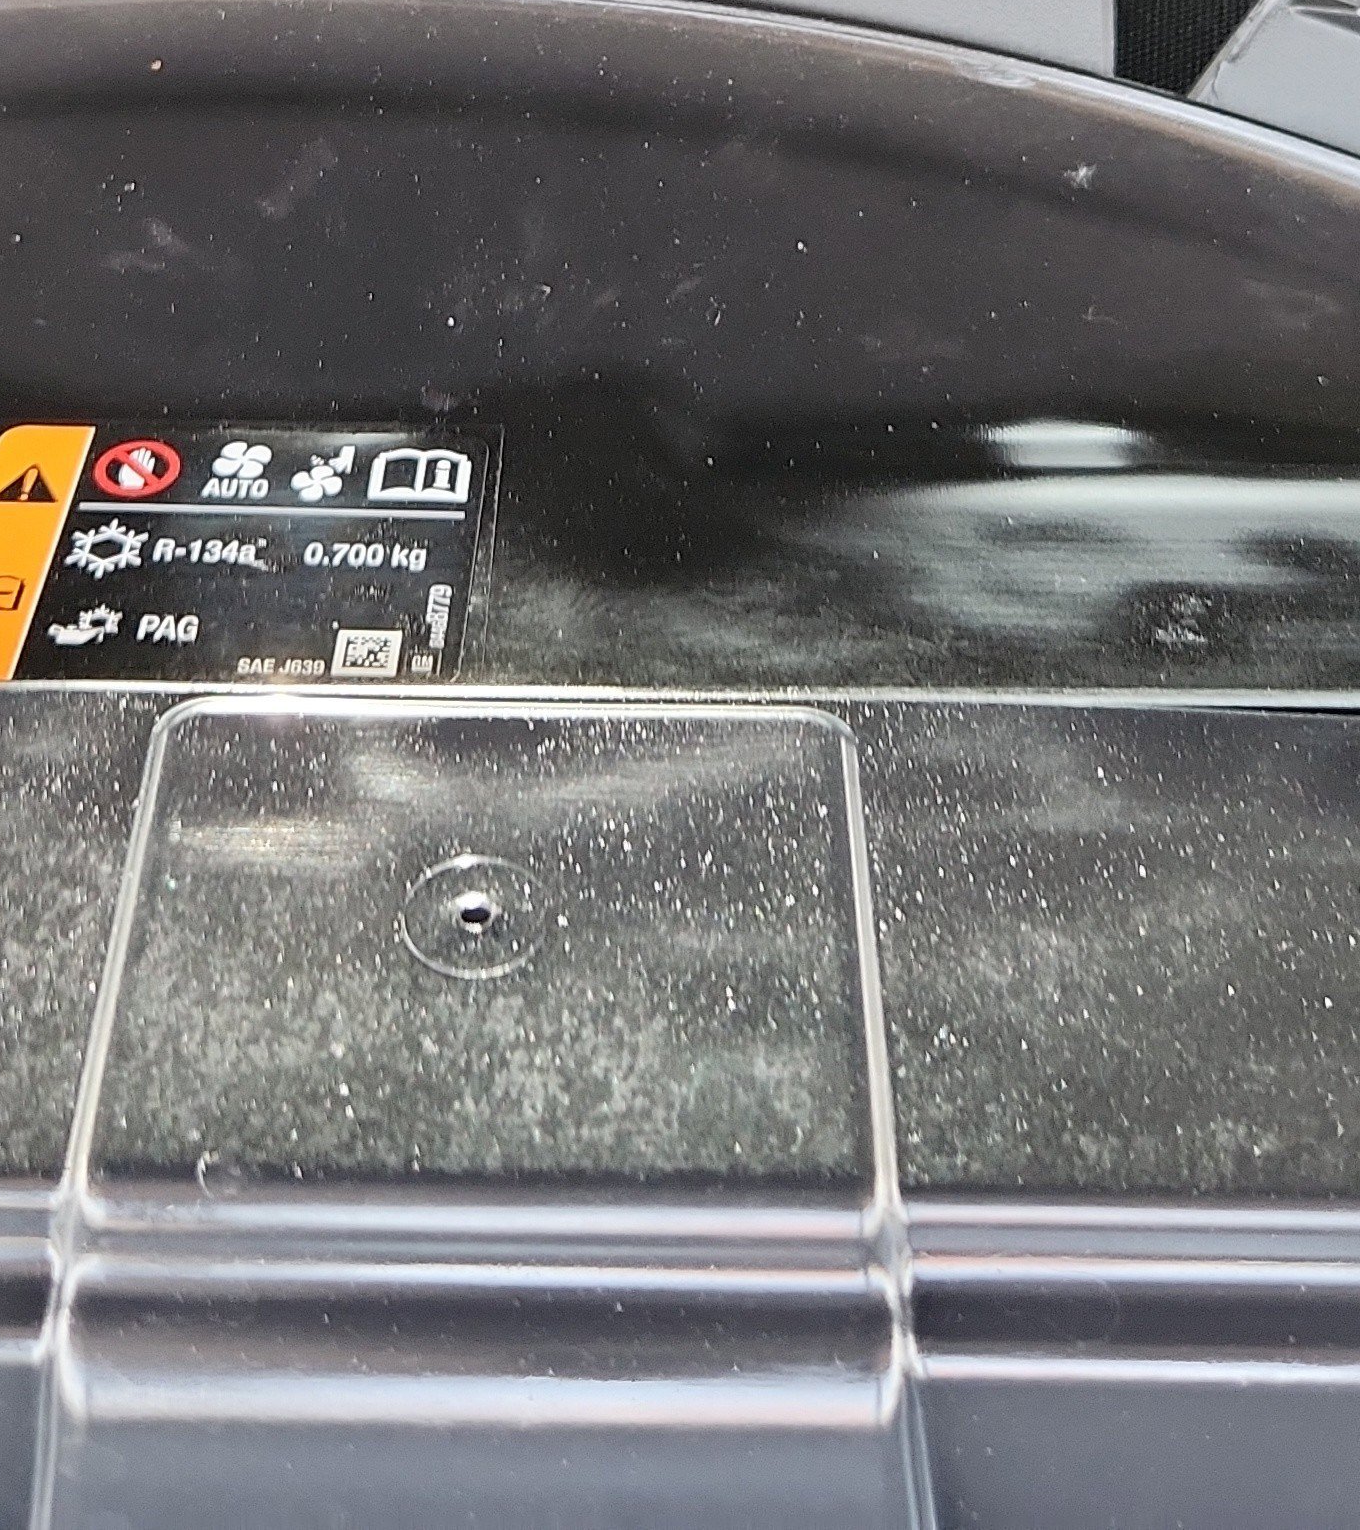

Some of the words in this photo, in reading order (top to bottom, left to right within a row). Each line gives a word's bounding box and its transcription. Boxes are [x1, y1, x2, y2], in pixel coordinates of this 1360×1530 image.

[201, 478, 269, 499] AUTO
[152, 537, 257, 566] R-134a
[304, 540, 384, 568] 0.700
[391, 542, 428, 572] kg
[136, 614, 200, 643] PAG
[237, 657, 275, 676] SAE
[278, 658, 326, 676] J639
